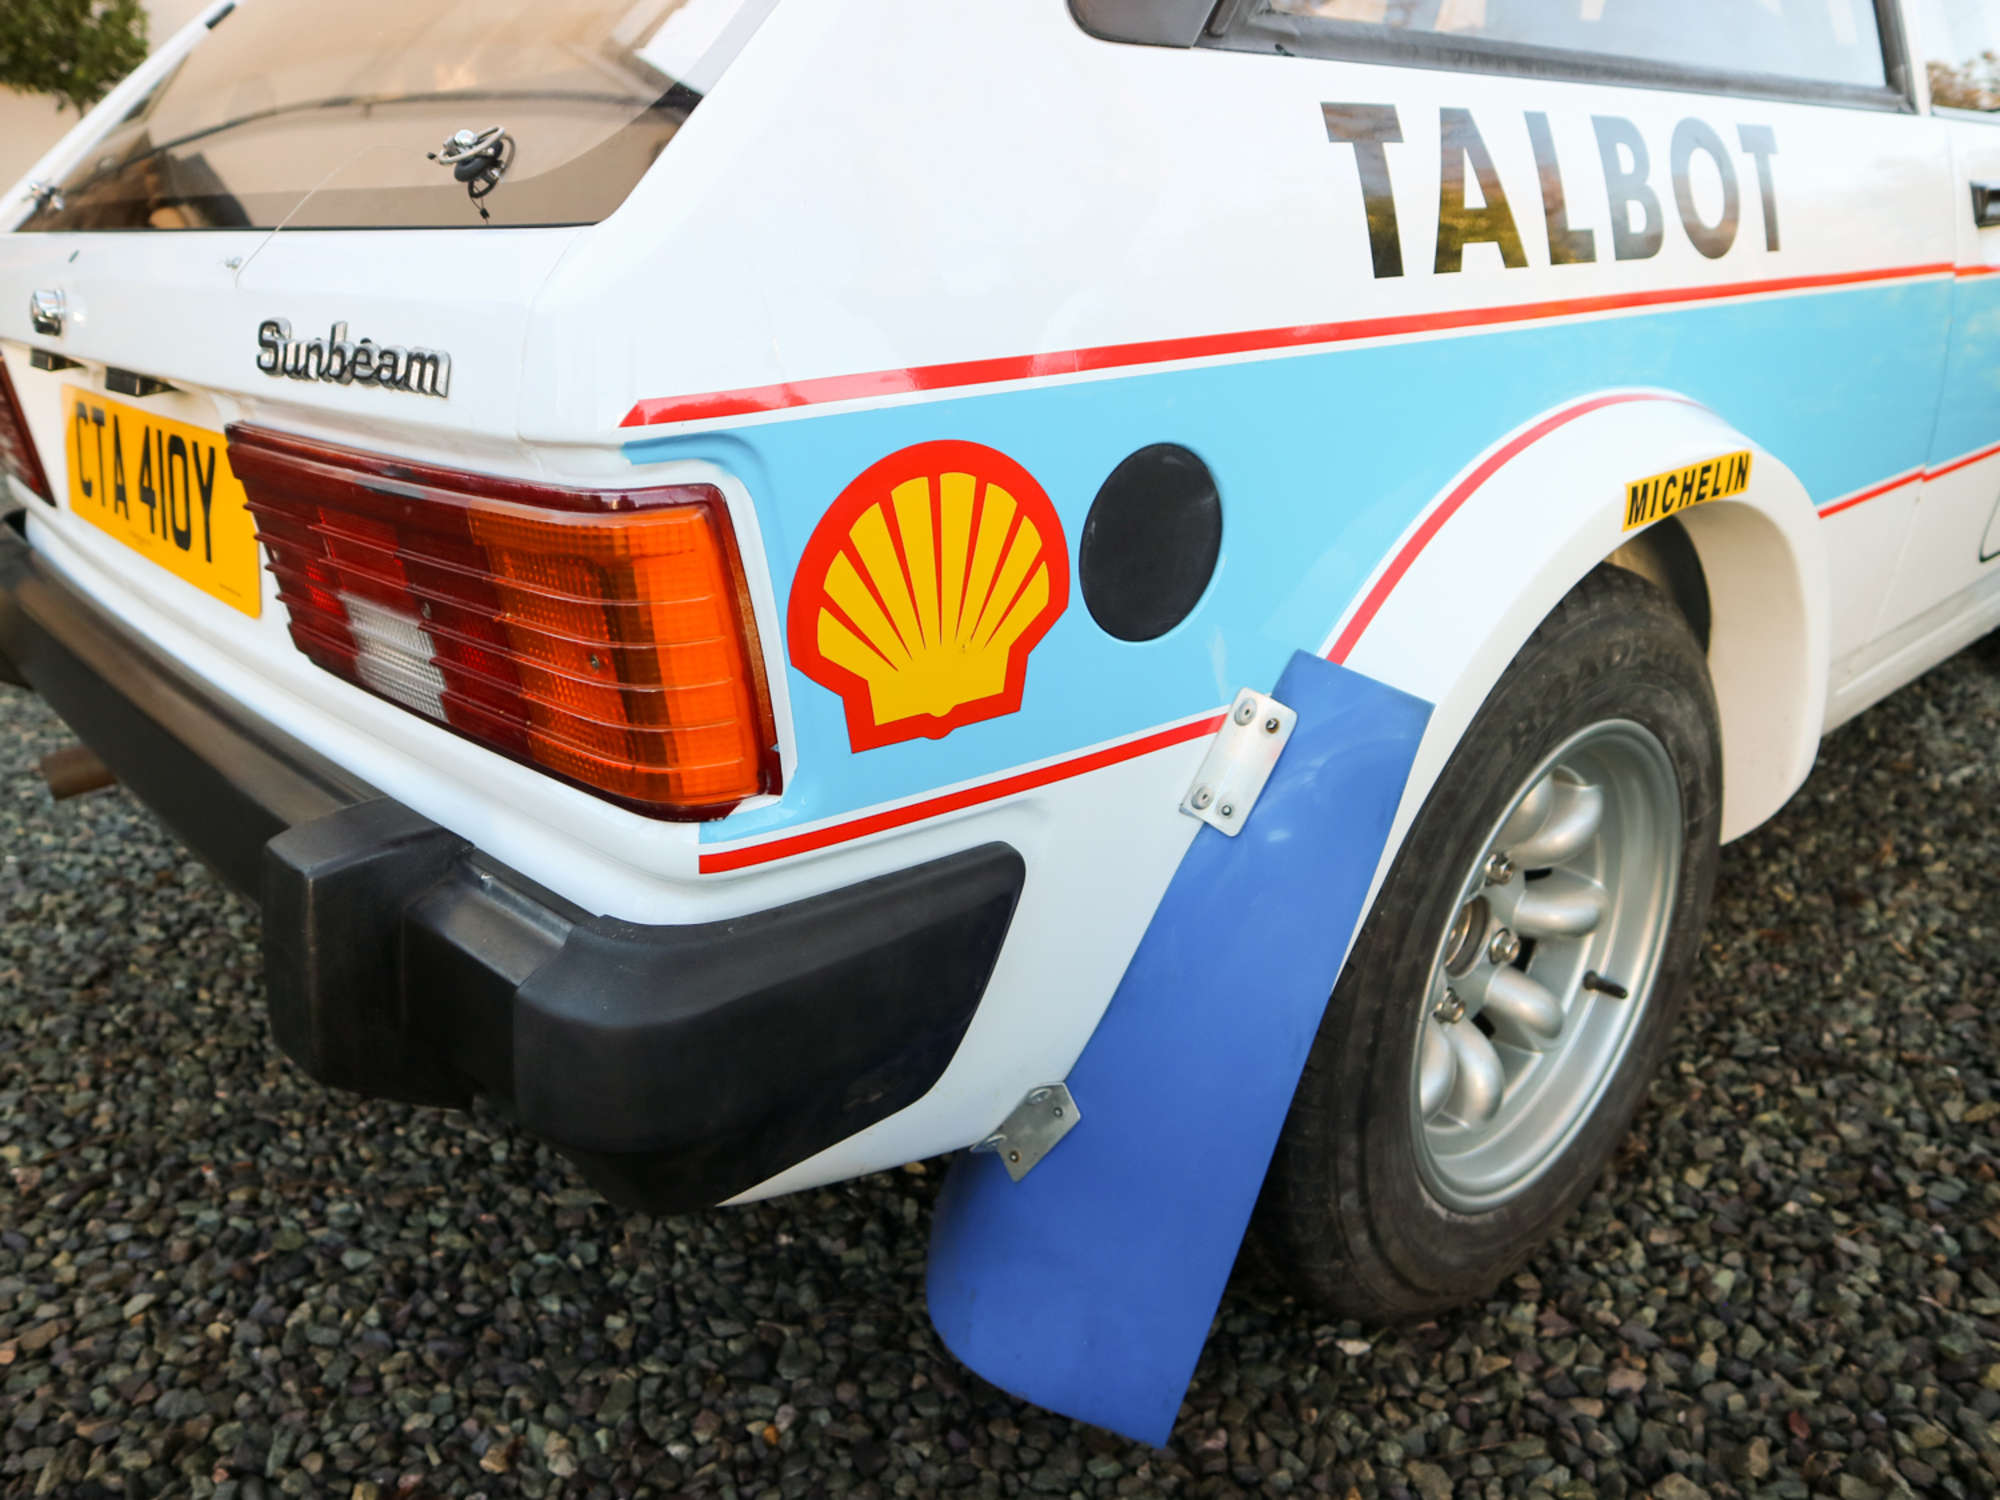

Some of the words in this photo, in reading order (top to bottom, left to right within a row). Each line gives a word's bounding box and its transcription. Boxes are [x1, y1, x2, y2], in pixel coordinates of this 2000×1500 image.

[1320, 101, 1781, 279] TALBOT
[256, 318, 452, 399] Sunbeam
[76, 400, 130, 521] CTA
[139, 424, 215, 564] 410Y
[1627, 452, 1750, 526] MICHELIN
